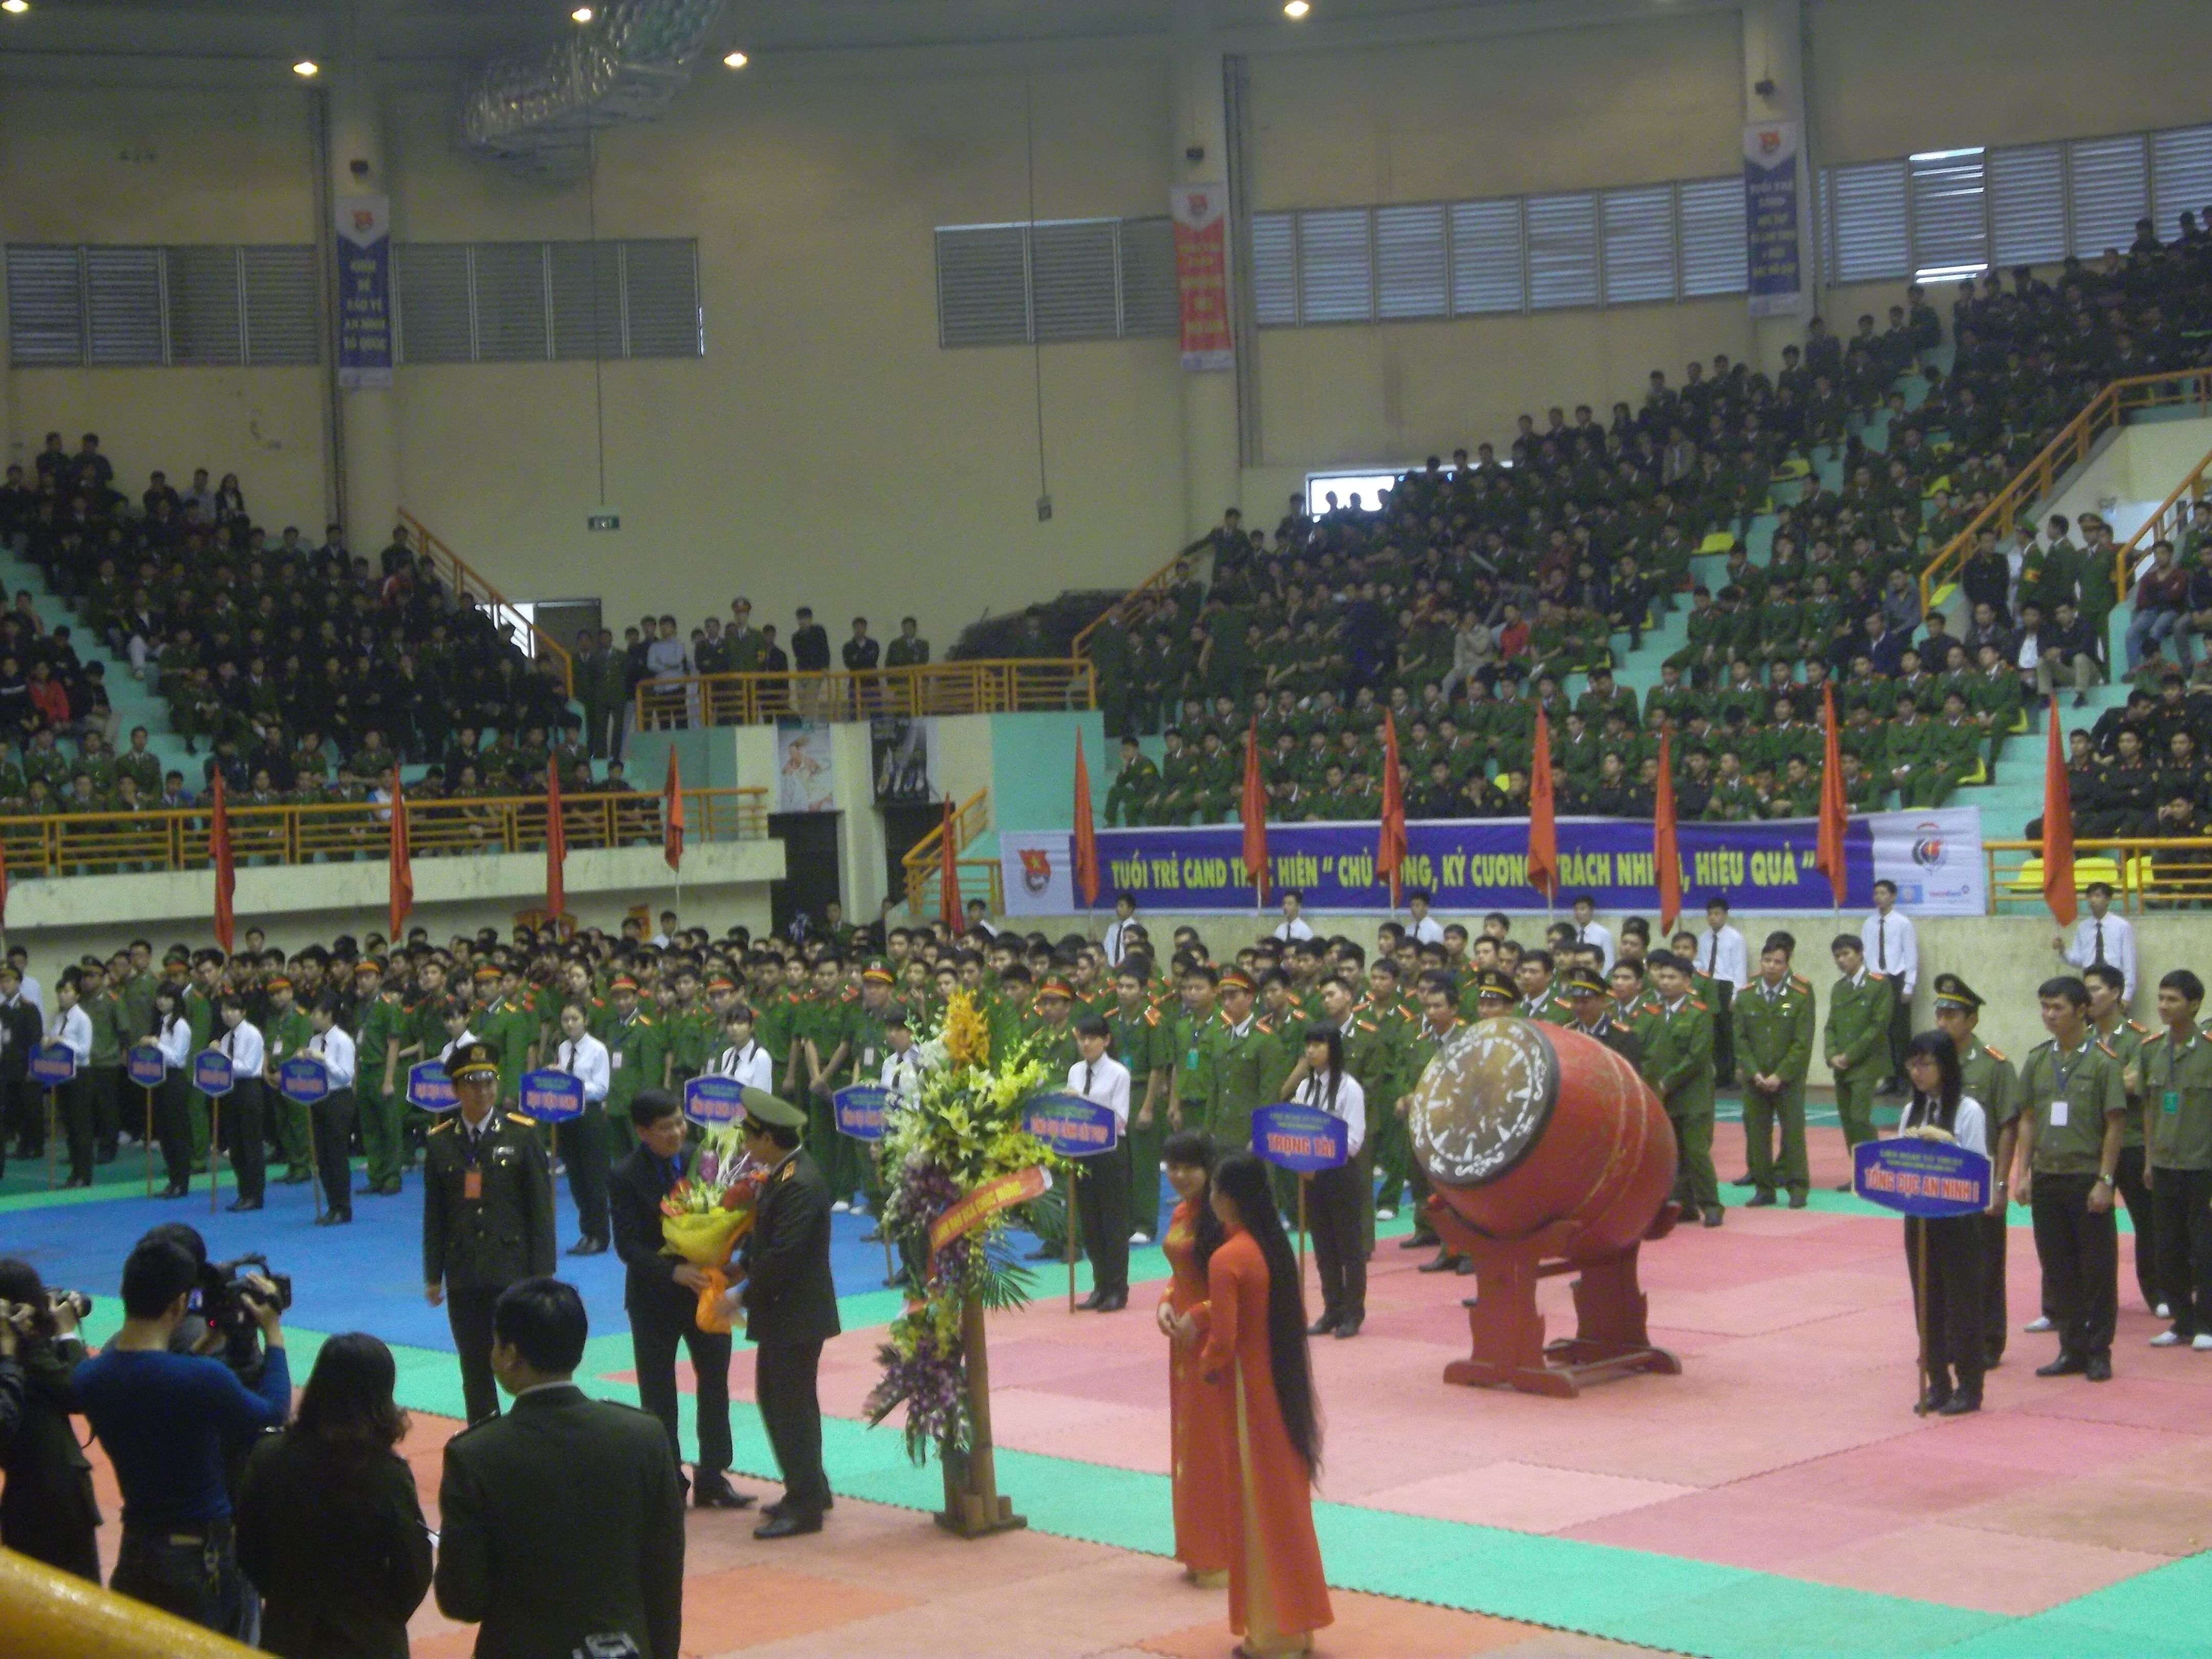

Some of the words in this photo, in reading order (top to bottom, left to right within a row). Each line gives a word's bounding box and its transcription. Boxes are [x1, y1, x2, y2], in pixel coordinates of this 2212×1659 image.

[1183, 857, 1227, 889] CAND
[1277, 849, 1318, 893] HIỆN
[1337, 846, 1373, 888] CHỦ
[1694, 844, 1744, 894] HIỆU
[1923, 1177, 1940, 1197] AN
[1941, 1179, 1971, 1202] NINH
